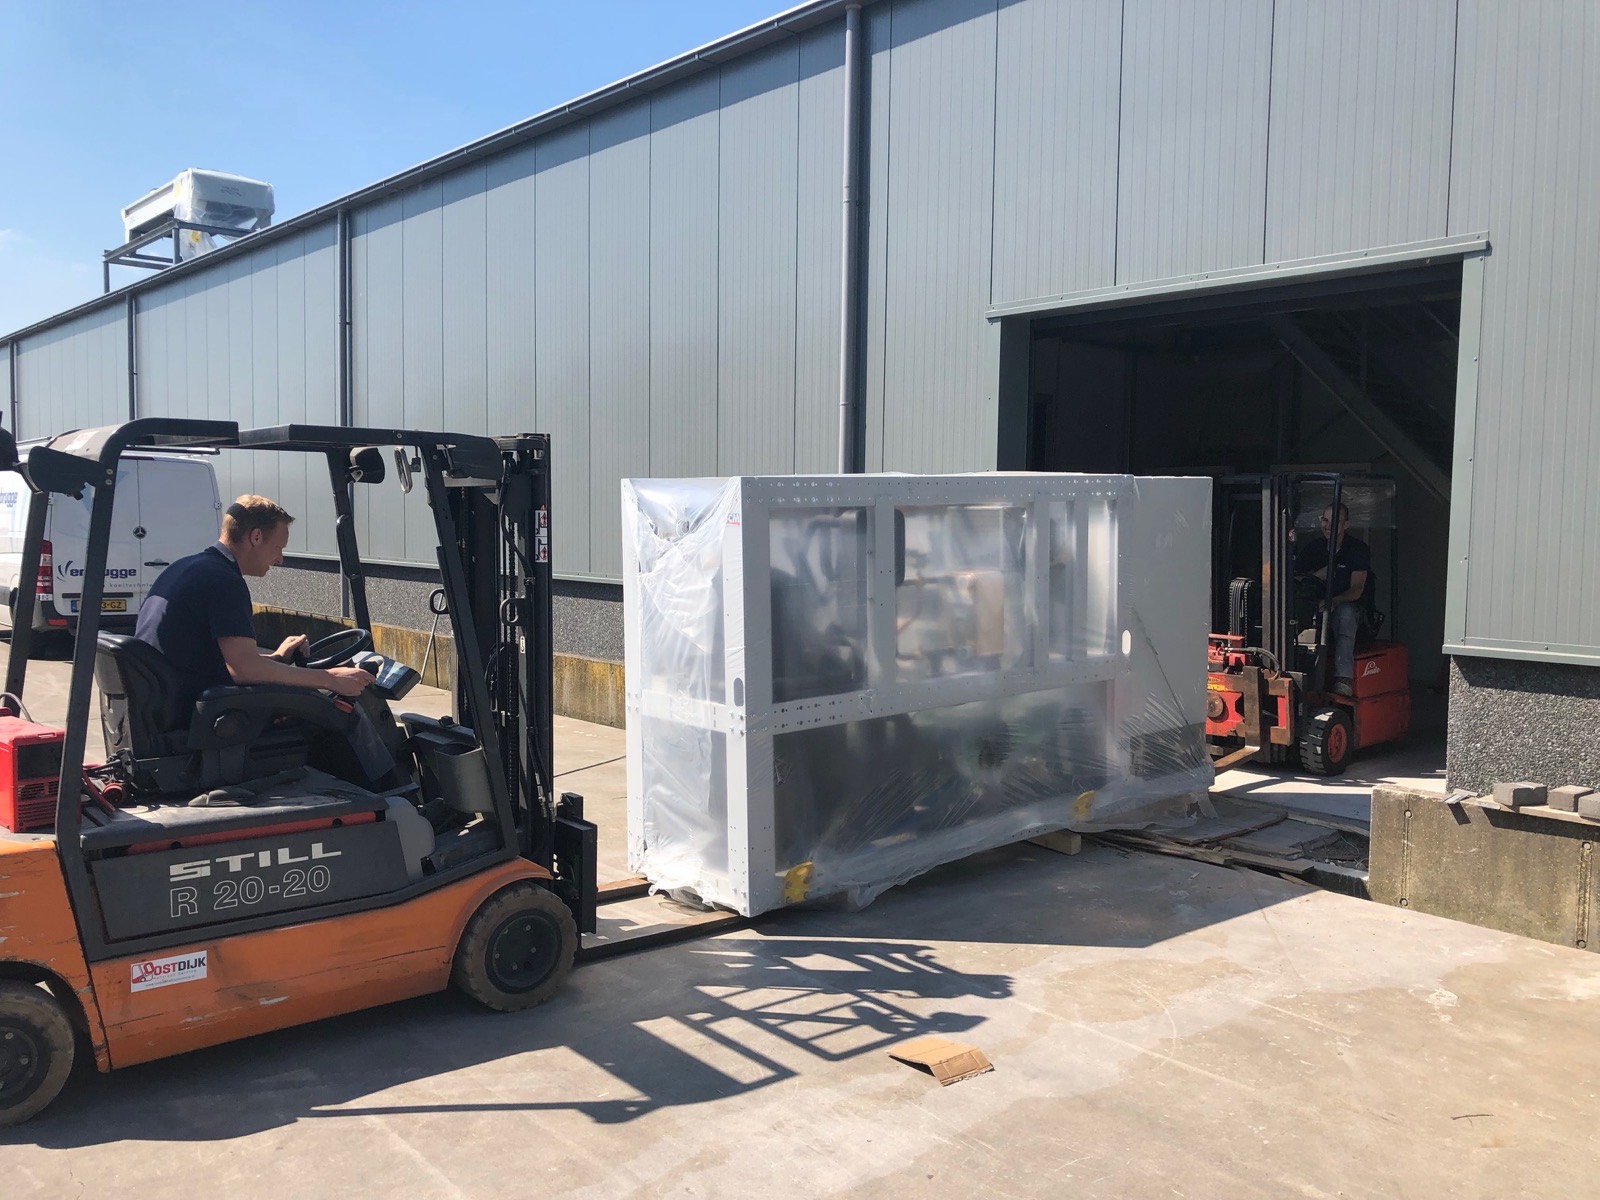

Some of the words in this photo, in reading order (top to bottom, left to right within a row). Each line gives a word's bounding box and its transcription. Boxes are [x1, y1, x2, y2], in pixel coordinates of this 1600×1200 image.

[169, 842, 342, 882] STILL
[170, 886, 198, 918] R
[213, 865, 331, 911] 20-20
[143, 957, 206, 976] OOSTDIJK
